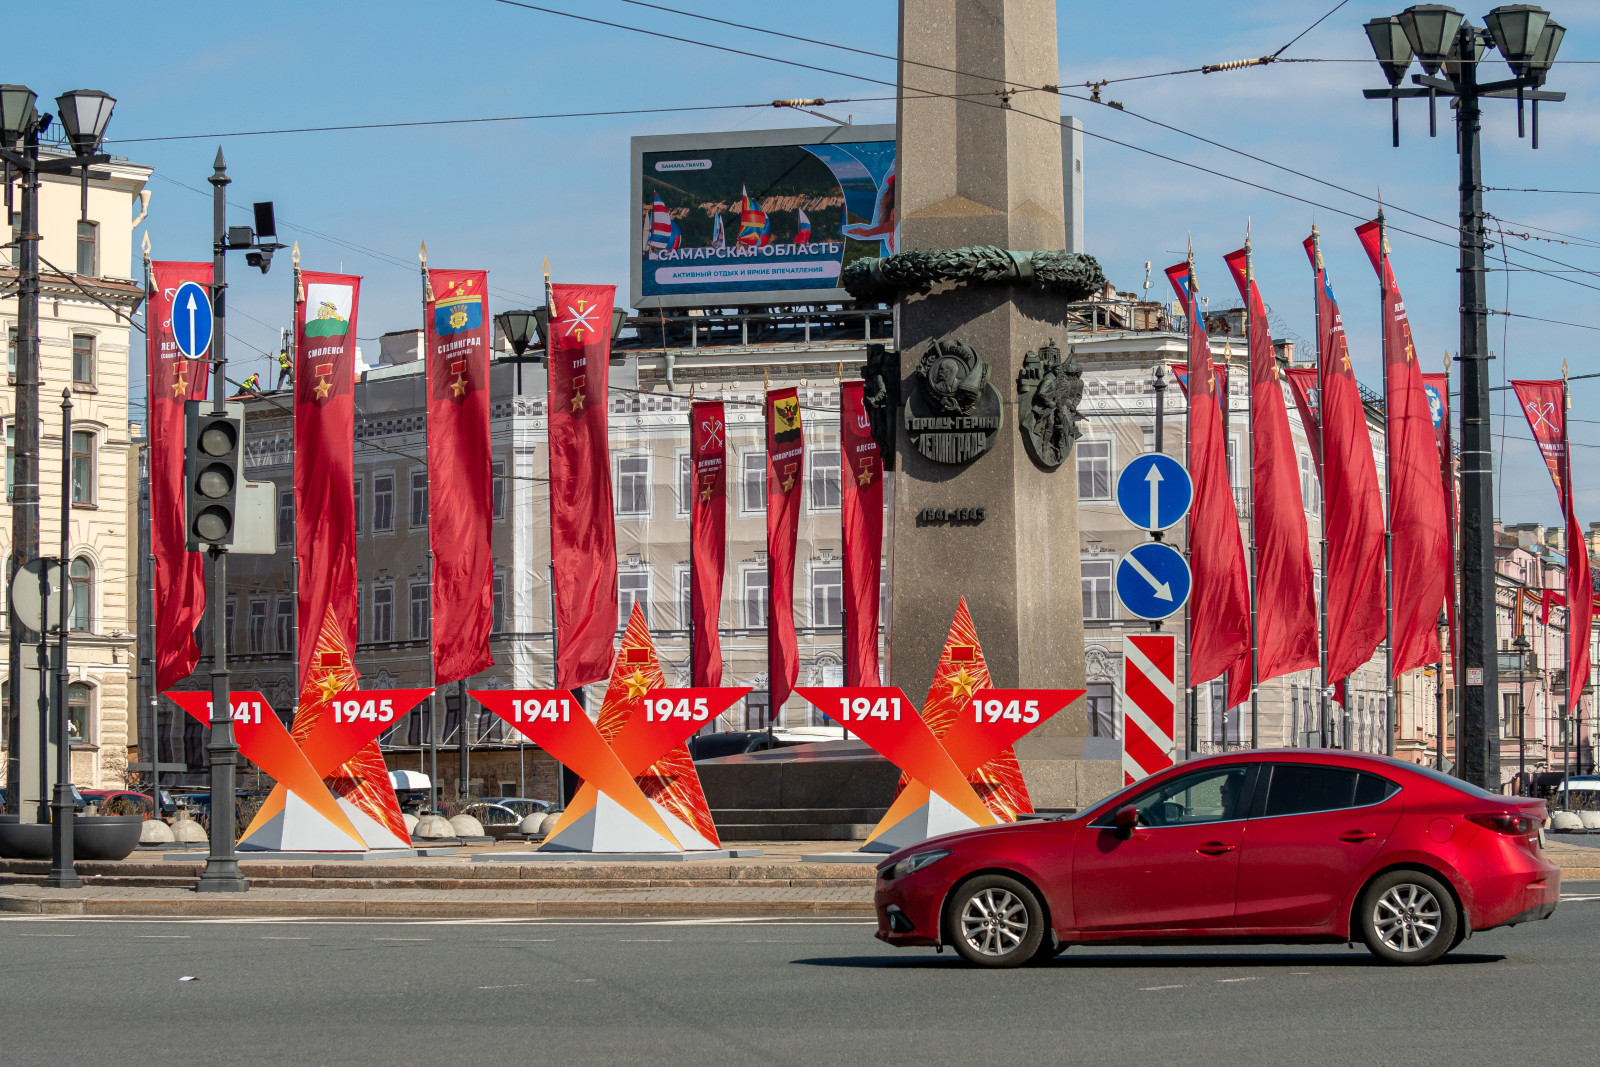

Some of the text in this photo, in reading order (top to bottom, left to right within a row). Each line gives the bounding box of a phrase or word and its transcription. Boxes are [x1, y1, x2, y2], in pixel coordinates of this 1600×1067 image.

[658, 242, 840, 261] САМАРСКАЯ ОБЛАСТЬ
[672, 271, 712, 279] АКТИВНЫЙ
[771, 266, 823, 274] ВПЕЧАТЛЕНИЯ
[437, 336, 481, 354] СТАЛИНГРАД
[918, 432, 987, 464] ЛЕНИНГРАДУ
[206, 702, 262, 724] 141
[333, 700, 394, 723] 1945
[512, 699, 570, 722] 1941
[644, 698, 709, 722] 1945
[840, 697, 901, 721] 1941
[972, 700, 1040, 723] 1945
